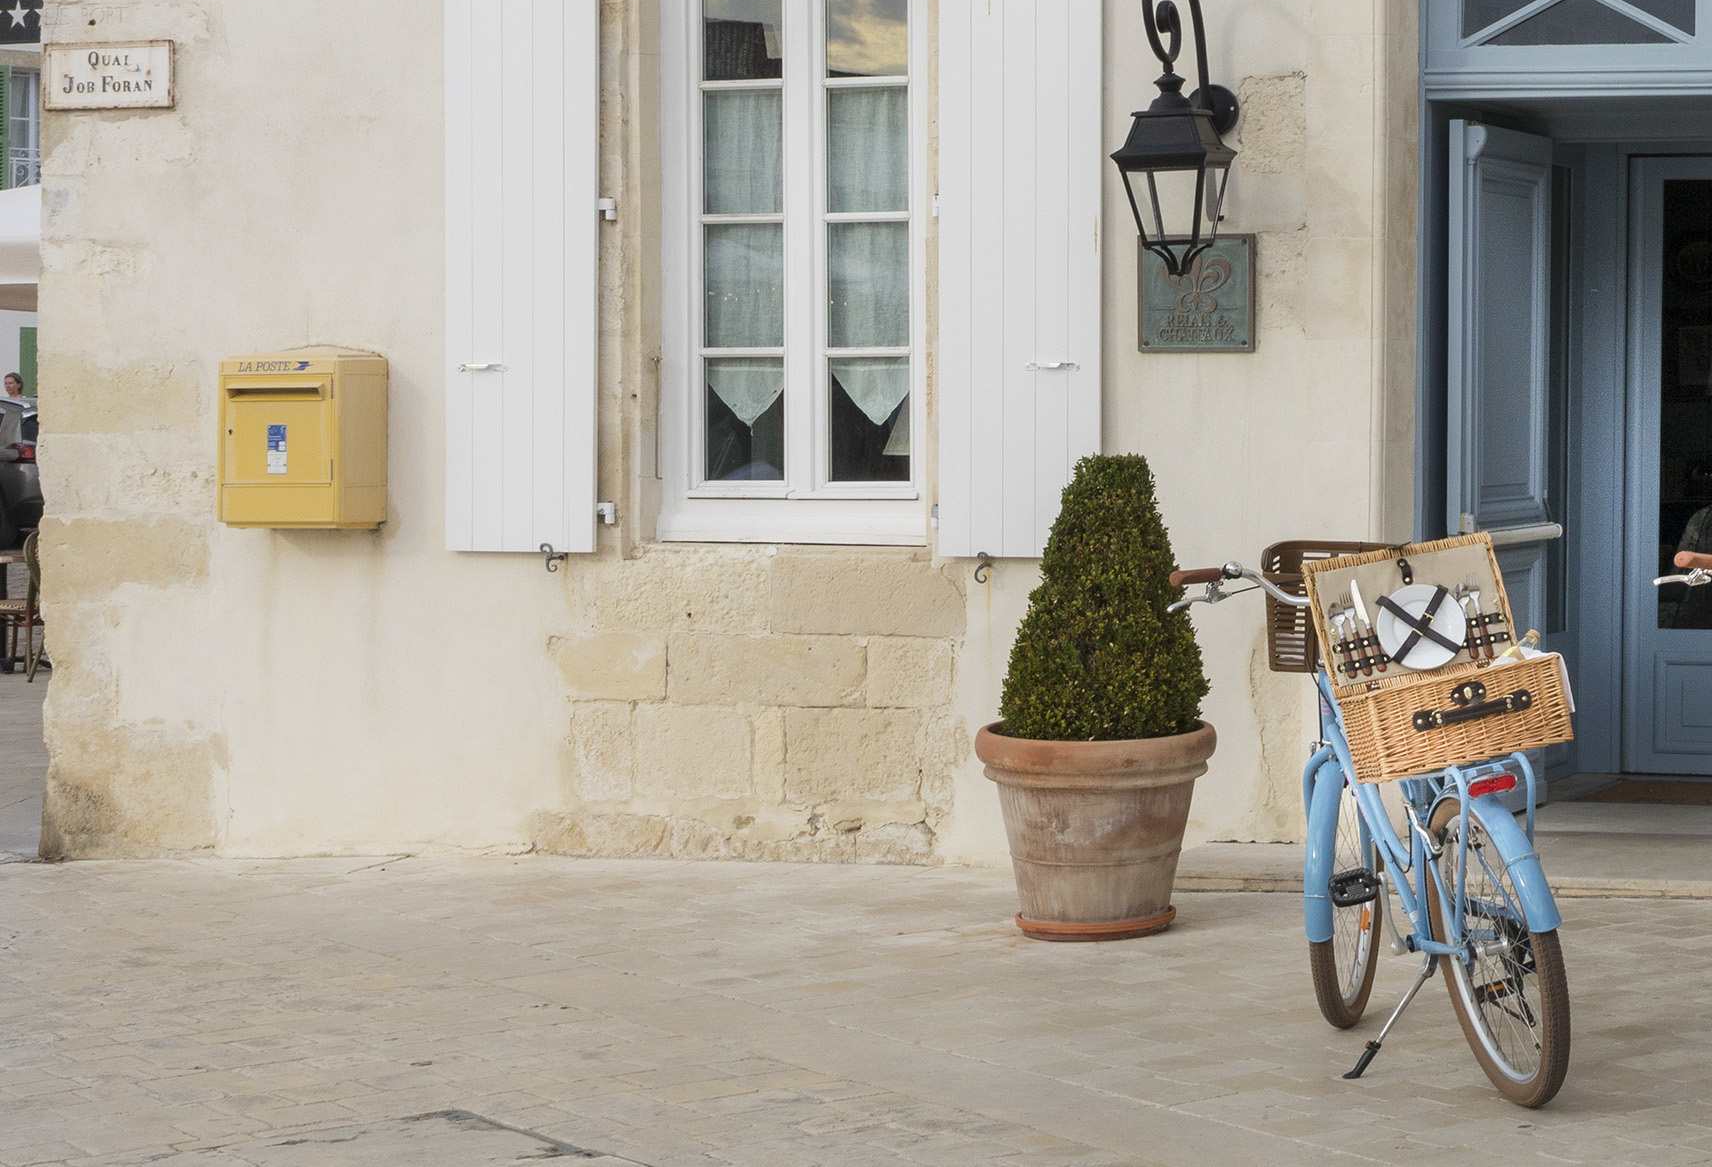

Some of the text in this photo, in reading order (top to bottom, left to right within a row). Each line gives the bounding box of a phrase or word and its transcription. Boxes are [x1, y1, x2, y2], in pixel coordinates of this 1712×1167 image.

[88, 51, 129, 70] QUAI
[101, 75, 152, 93] FORAN
[1166, 313, 1229, 328] RELAIS &
[238, 361, 292, 372] LA POSTE
